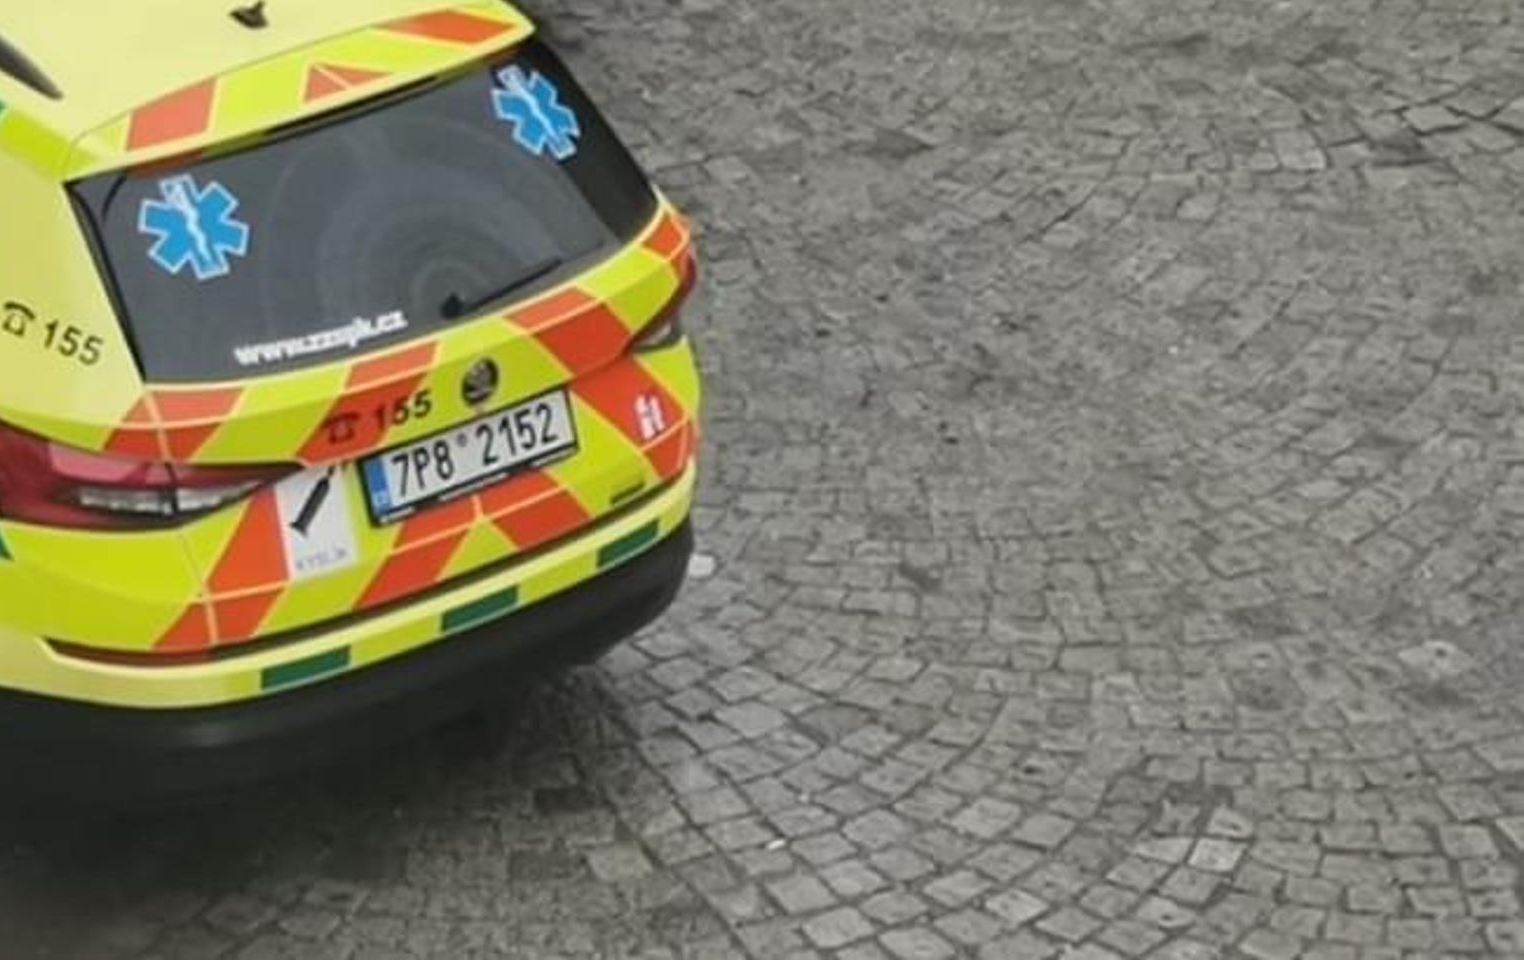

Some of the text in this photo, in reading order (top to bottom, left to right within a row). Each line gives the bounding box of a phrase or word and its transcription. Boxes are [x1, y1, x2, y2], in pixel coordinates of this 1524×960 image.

[43, 318, 105, 367] 155
[376, 387, 433, 432] 155
[391, 438, 455, 498] 7P8
[475, 401, 559, 467] 2152
